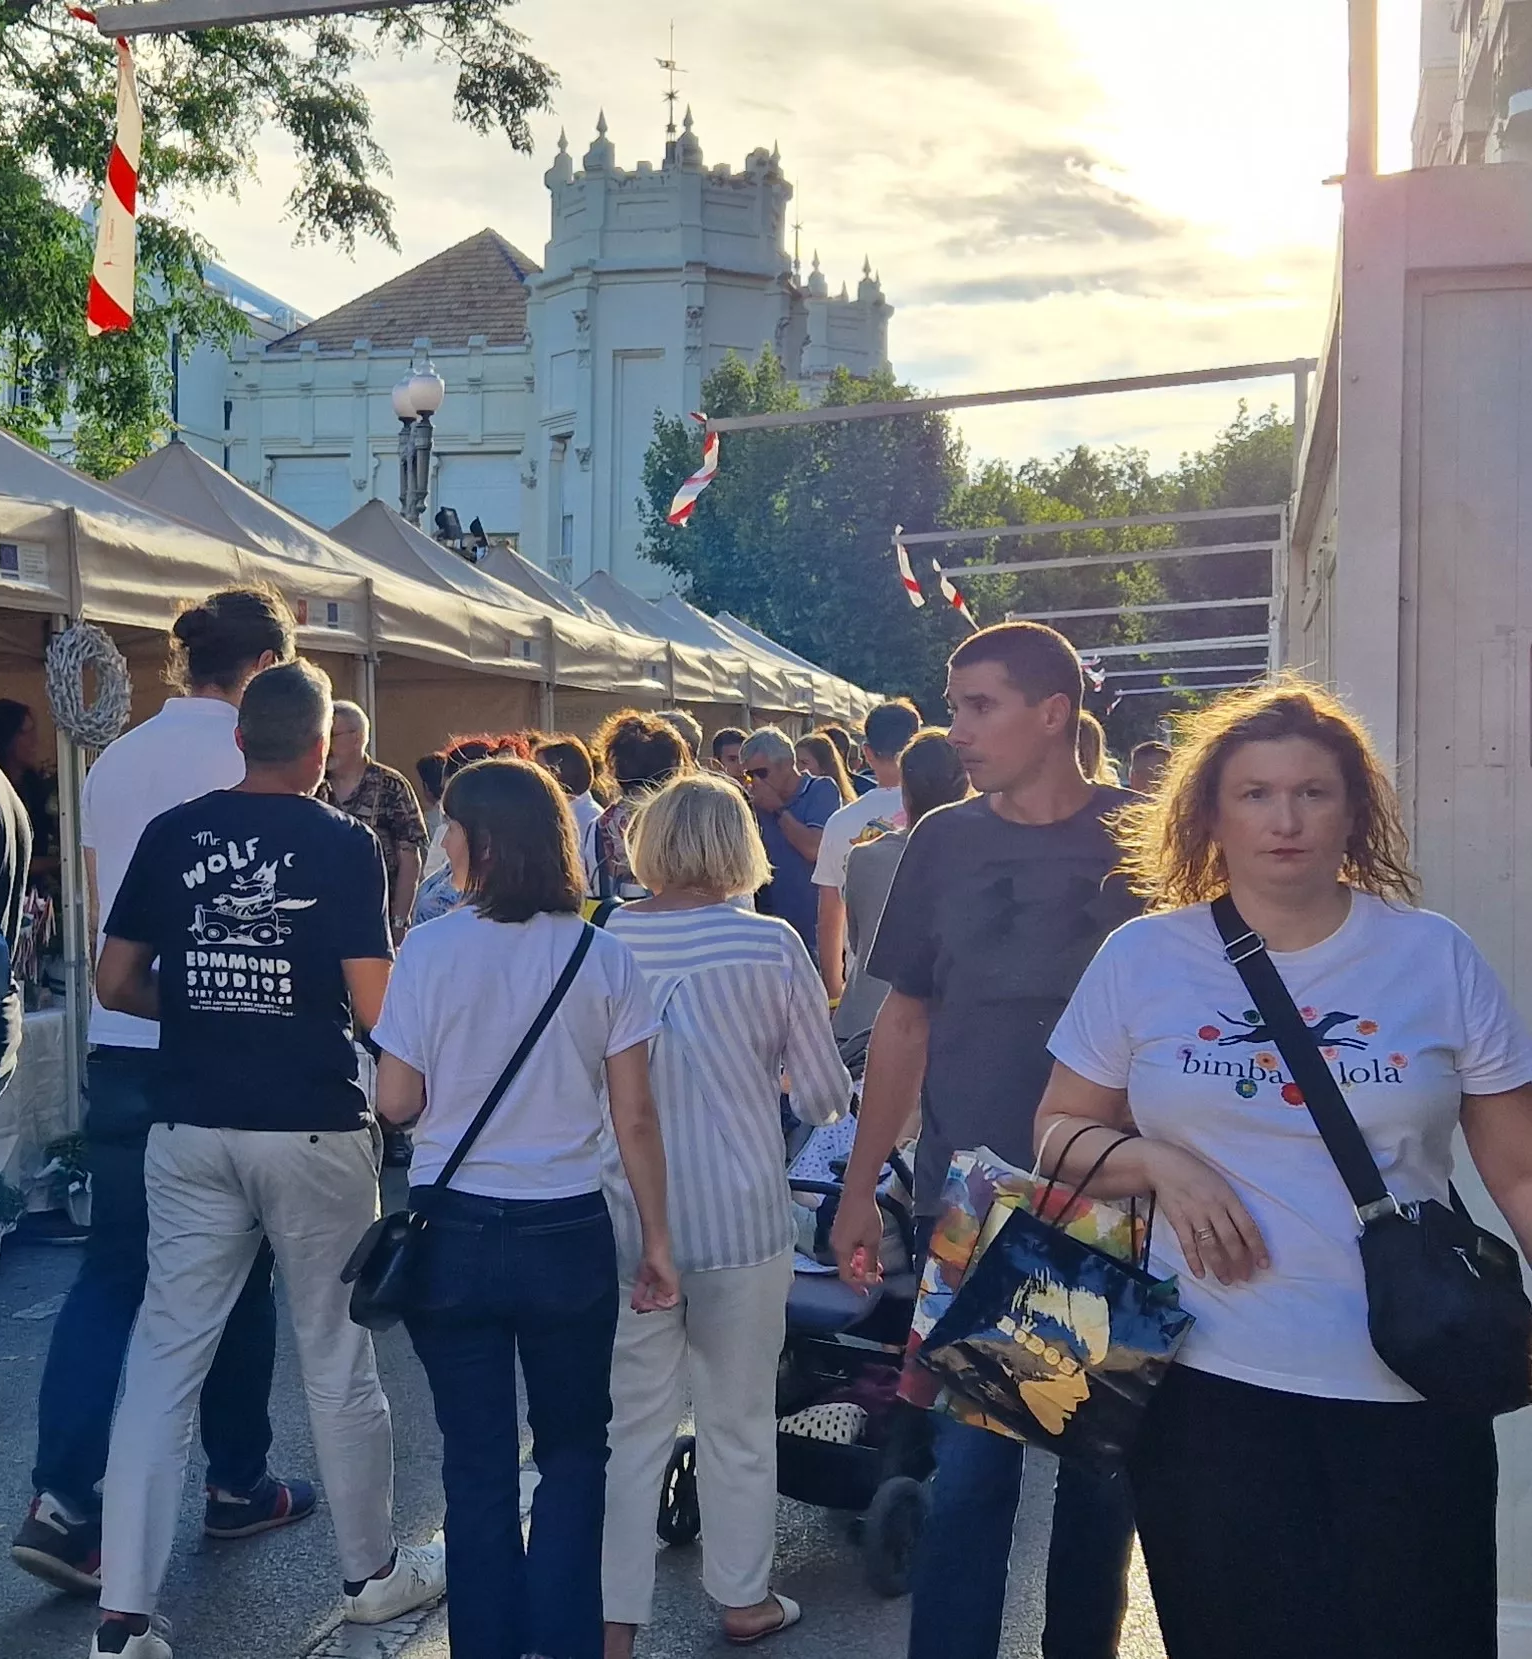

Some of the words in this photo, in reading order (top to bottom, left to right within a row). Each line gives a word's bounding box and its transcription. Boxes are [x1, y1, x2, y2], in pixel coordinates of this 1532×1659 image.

[182, 836, 261, 890] WOLF
[186, 951, 291, 974] EDMMOND
[187, 970, 293, 993] STUDIOS
[1182, 1050, 1286, 1085] bimba
[1339, 1058, 1403, 1085] lola
